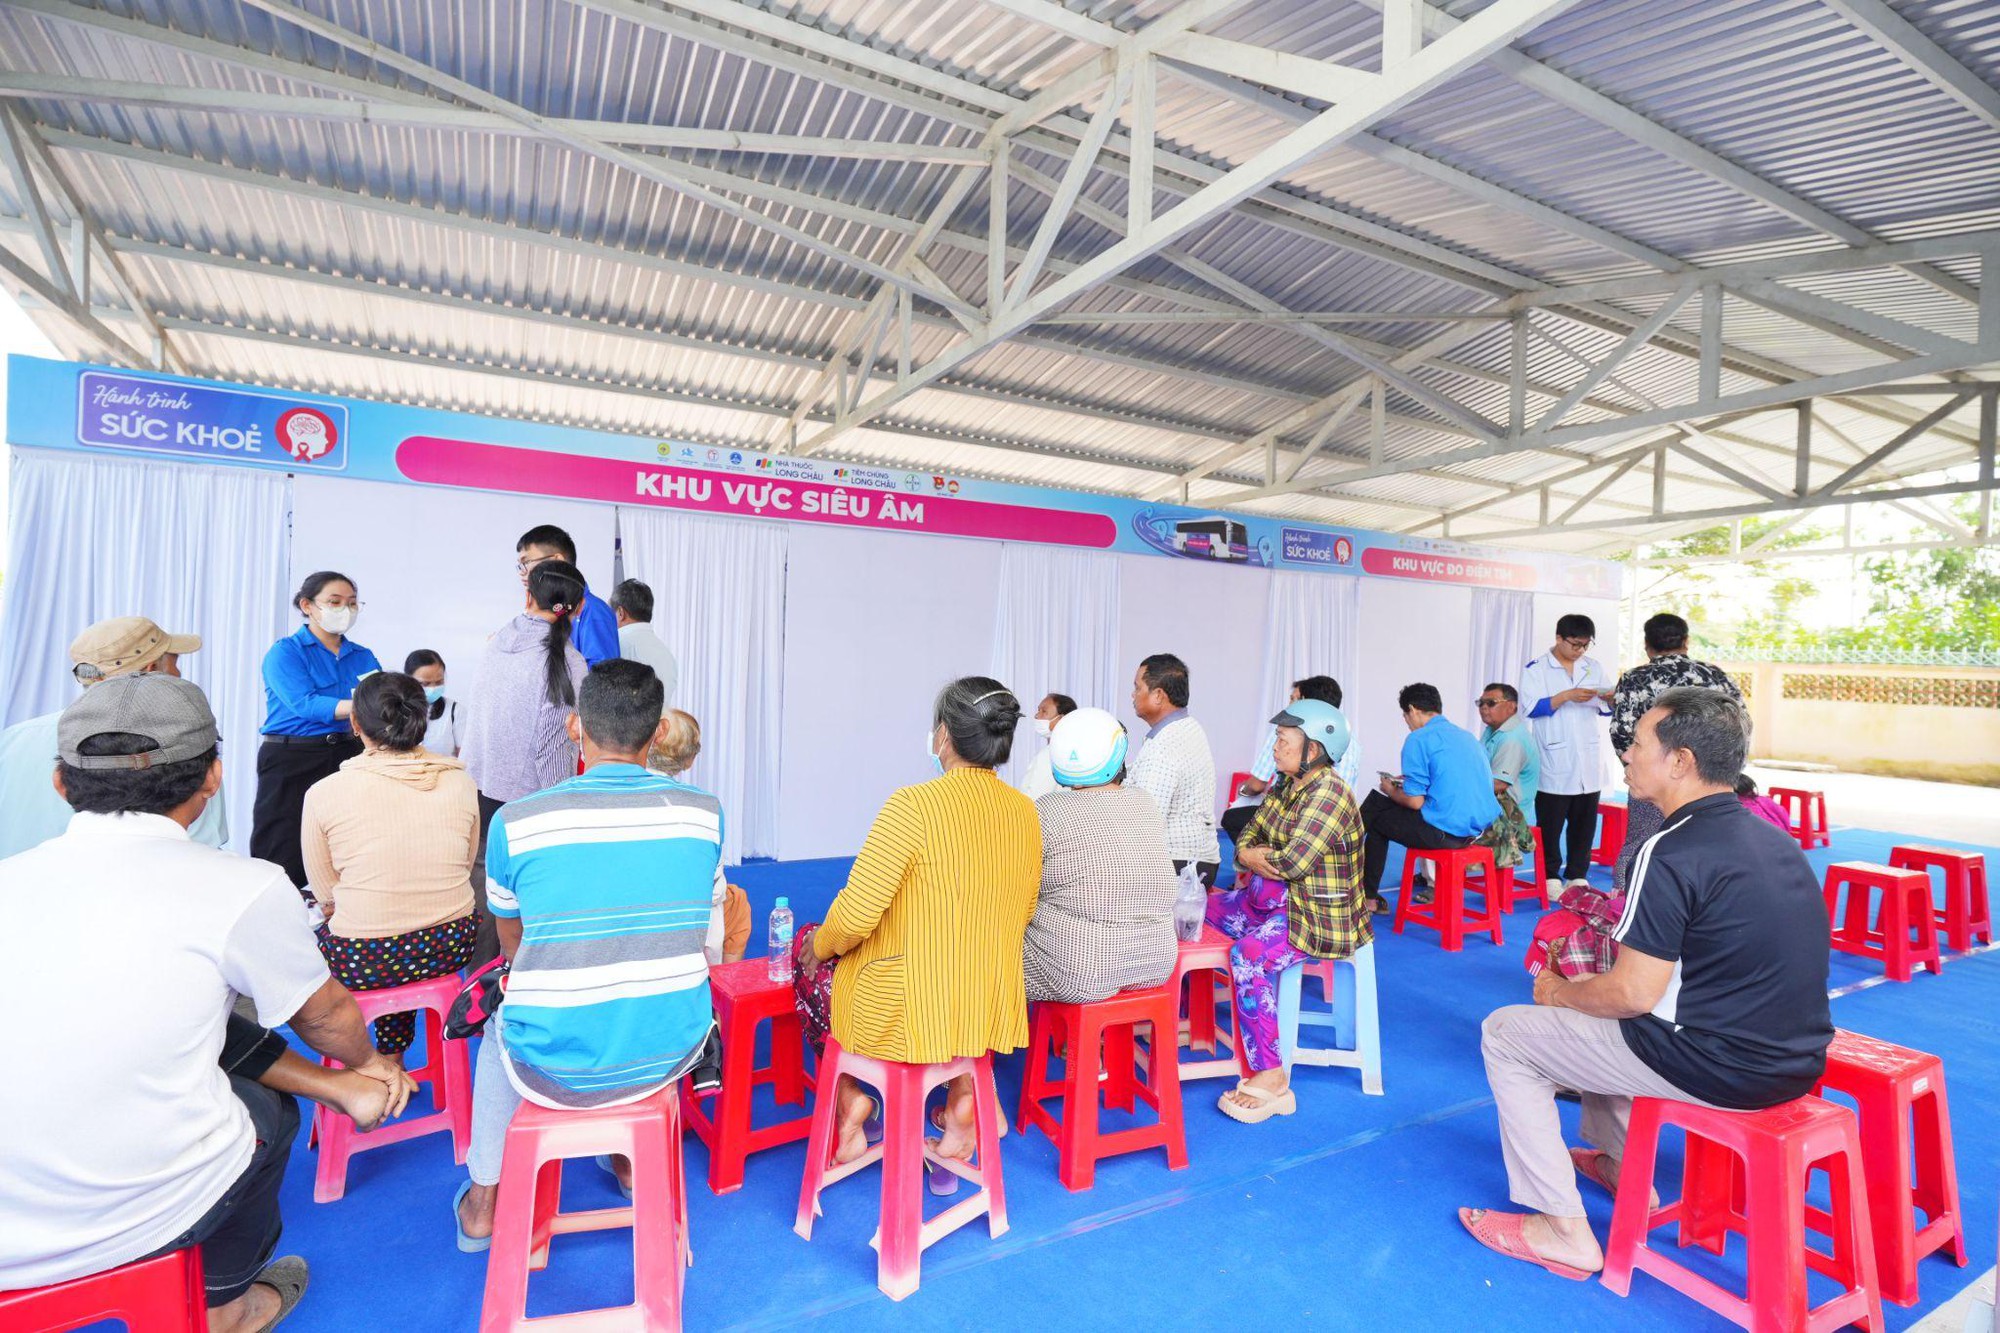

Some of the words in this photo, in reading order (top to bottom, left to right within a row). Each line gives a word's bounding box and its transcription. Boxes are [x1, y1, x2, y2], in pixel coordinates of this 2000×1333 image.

[93, 384, 144, 407] Hành
[145, 389, 192, 410] trình
[99, 409, 169, 441] SỨC
[176, 423, 262, 452] KHOẺ
[775, 468, 799, 478] LONG
[800, 470, 824, 481] CHÂU
[851, 477, 873, 486] LONG
[875, 479, 896, 489] CHÂU
[636, 471, 711, 501] KHU
[722, 482, 792, 513] VỰC
[801, 487, 870, 519] SIÊU
[878, 493, 925, 523] ÂM
[1286, 543, 1305, 558] SỨC
[1393, 557, 1418, 571] KHU
[1420, 559, 1444, 577] VỰC
